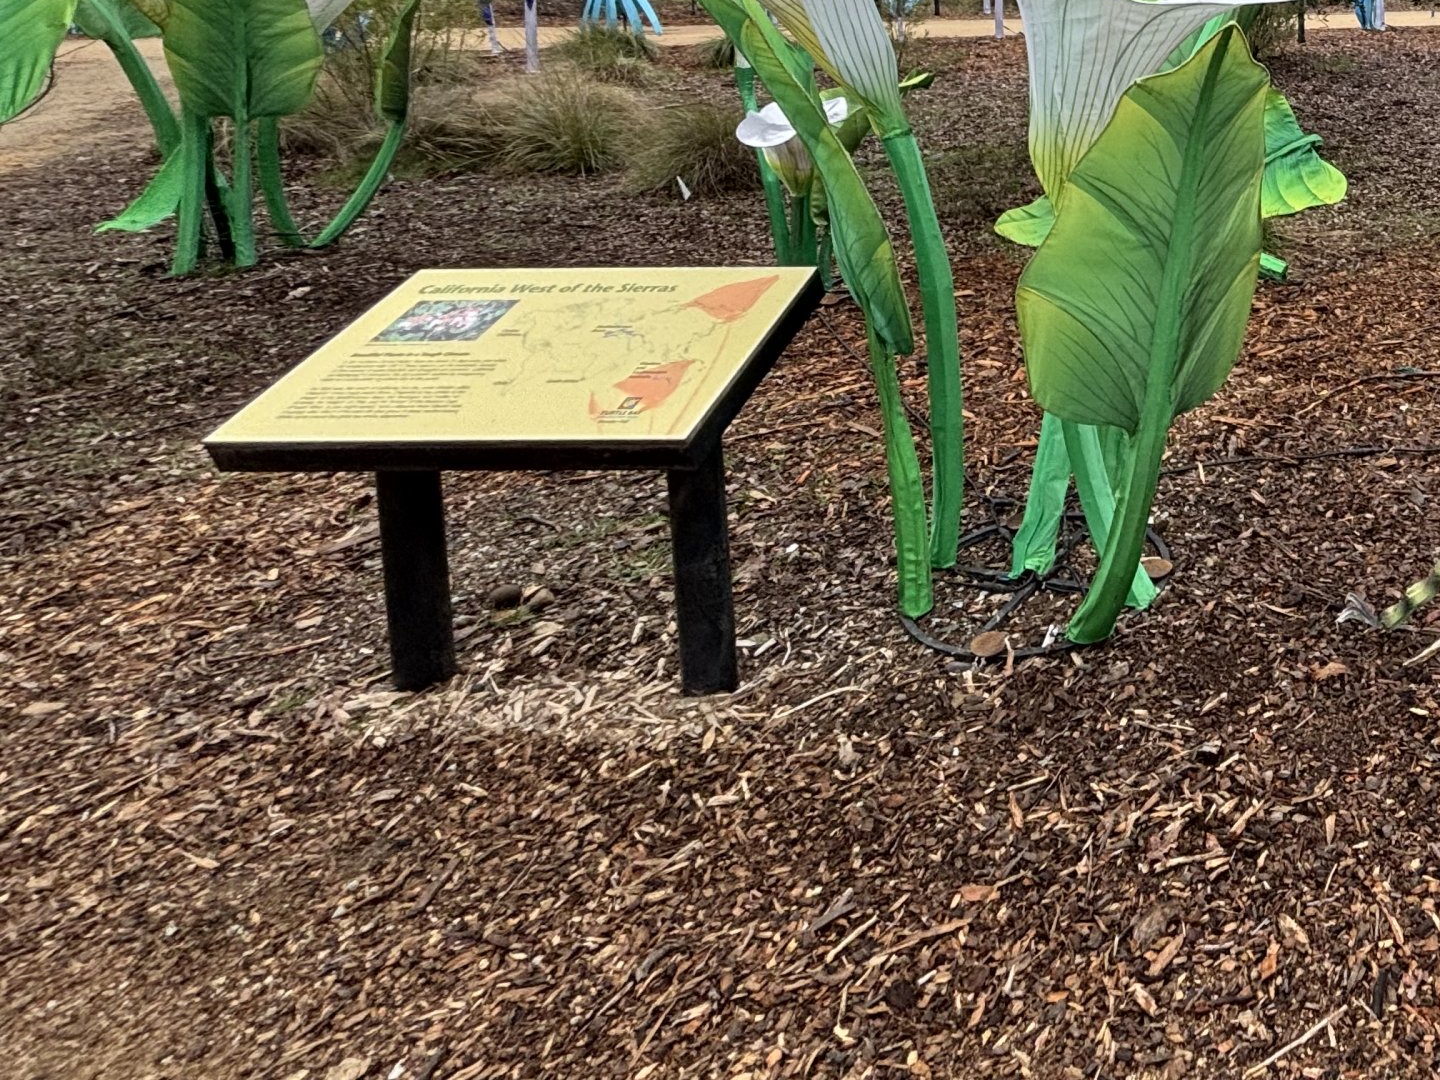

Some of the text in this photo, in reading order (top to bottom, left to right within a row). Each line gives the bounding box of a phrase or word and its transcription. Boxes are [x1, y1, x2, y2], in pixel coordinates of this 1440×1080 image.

[418, 283, 679, 295] California West of the Sierras
